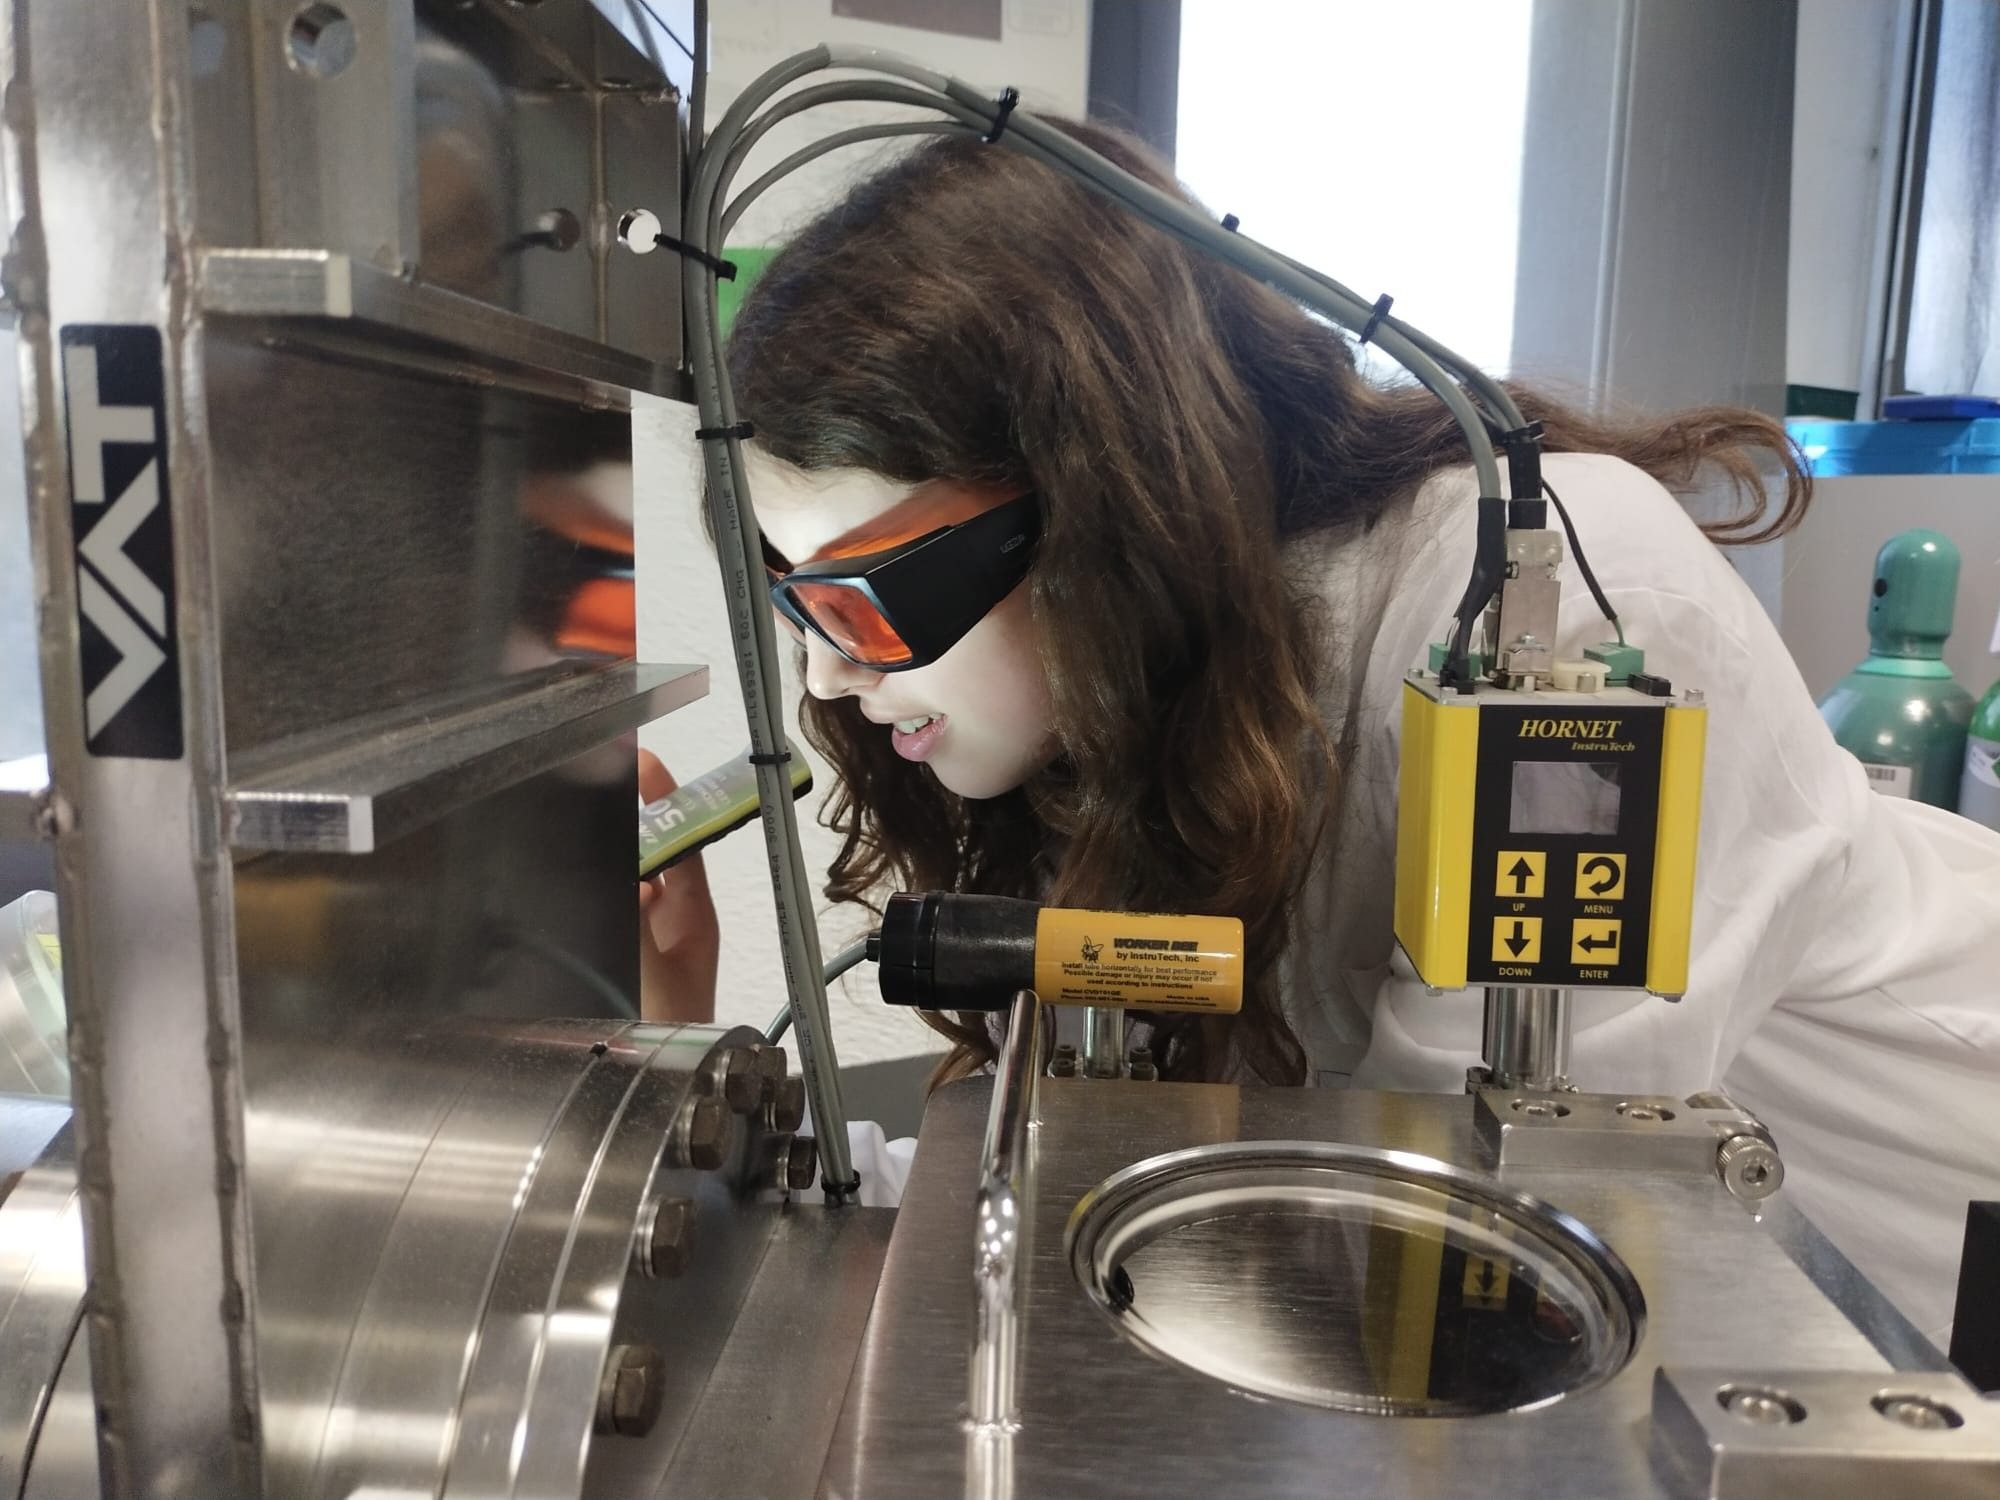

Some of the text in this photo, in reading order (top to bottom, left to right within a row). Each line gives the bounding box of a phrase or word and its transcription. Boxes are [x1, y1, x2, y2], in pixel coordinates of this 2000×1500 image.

[718, 456, 730, 477] IN
[723, 488, 738, 531] MADE
[66, 346, 167, 741] VAT
[734, 568, 746, 599] CMG
[1518, 719, 1622, 739] HORNET
[1571, 741, 1635, 752] InstruTech
[765, 804, 778, 844] 300V
[1512, 903, 1525, 912] UP
[1583, 905, 1613, 914] MENU
[1114, 938, 1169, 950] WORKER
[1116, 951, 1129, 961] by
[1064, 969, 1093, 977] Possible
[1095, 971, 1122, 979] damage
[1133, 973, 1153, 981] injury
[1101, 964, 1142, 973] horizontally
[1172, 968, 1217, 976] performance
[1498, 968, 1532, 977] DOWN
[1579, 970, 1609, 979] ENTER
[1105, 979, 1140, 987] according
[1150, 981, 1193, 989] instructions
